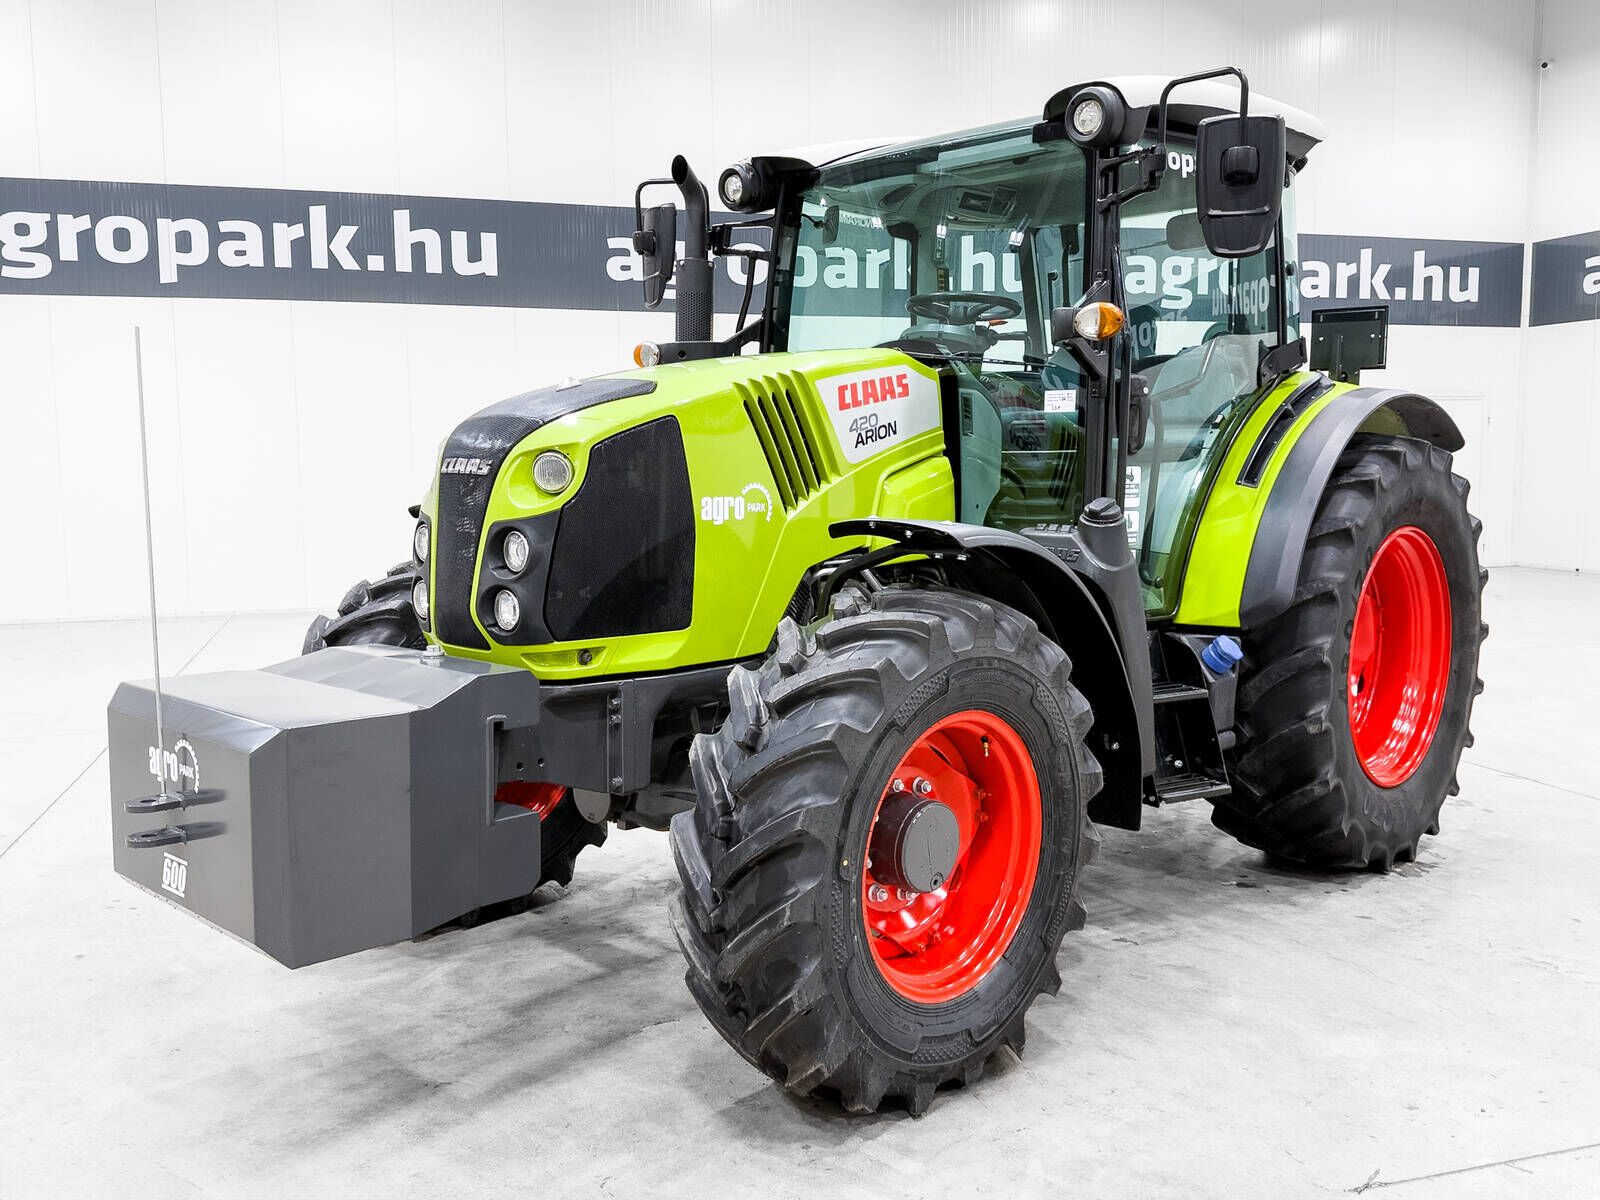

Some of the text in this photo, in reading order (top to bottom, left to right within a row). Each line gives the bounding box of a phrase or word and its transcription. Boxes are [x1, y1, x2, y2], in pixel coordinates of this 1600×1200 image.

[0, 205, 498, 284] gropark.hu
[838, 373, 910, 411] CLAAS
[848, 413, 879, 434] 420
[854, 420, 898, 449] ARION
[440, 457, 493, 476] CLAAS
[701, 496, 766, 525] agro PARK
[179, 763, 194, 780] PARK
[162, 857, 187, 893] 600
